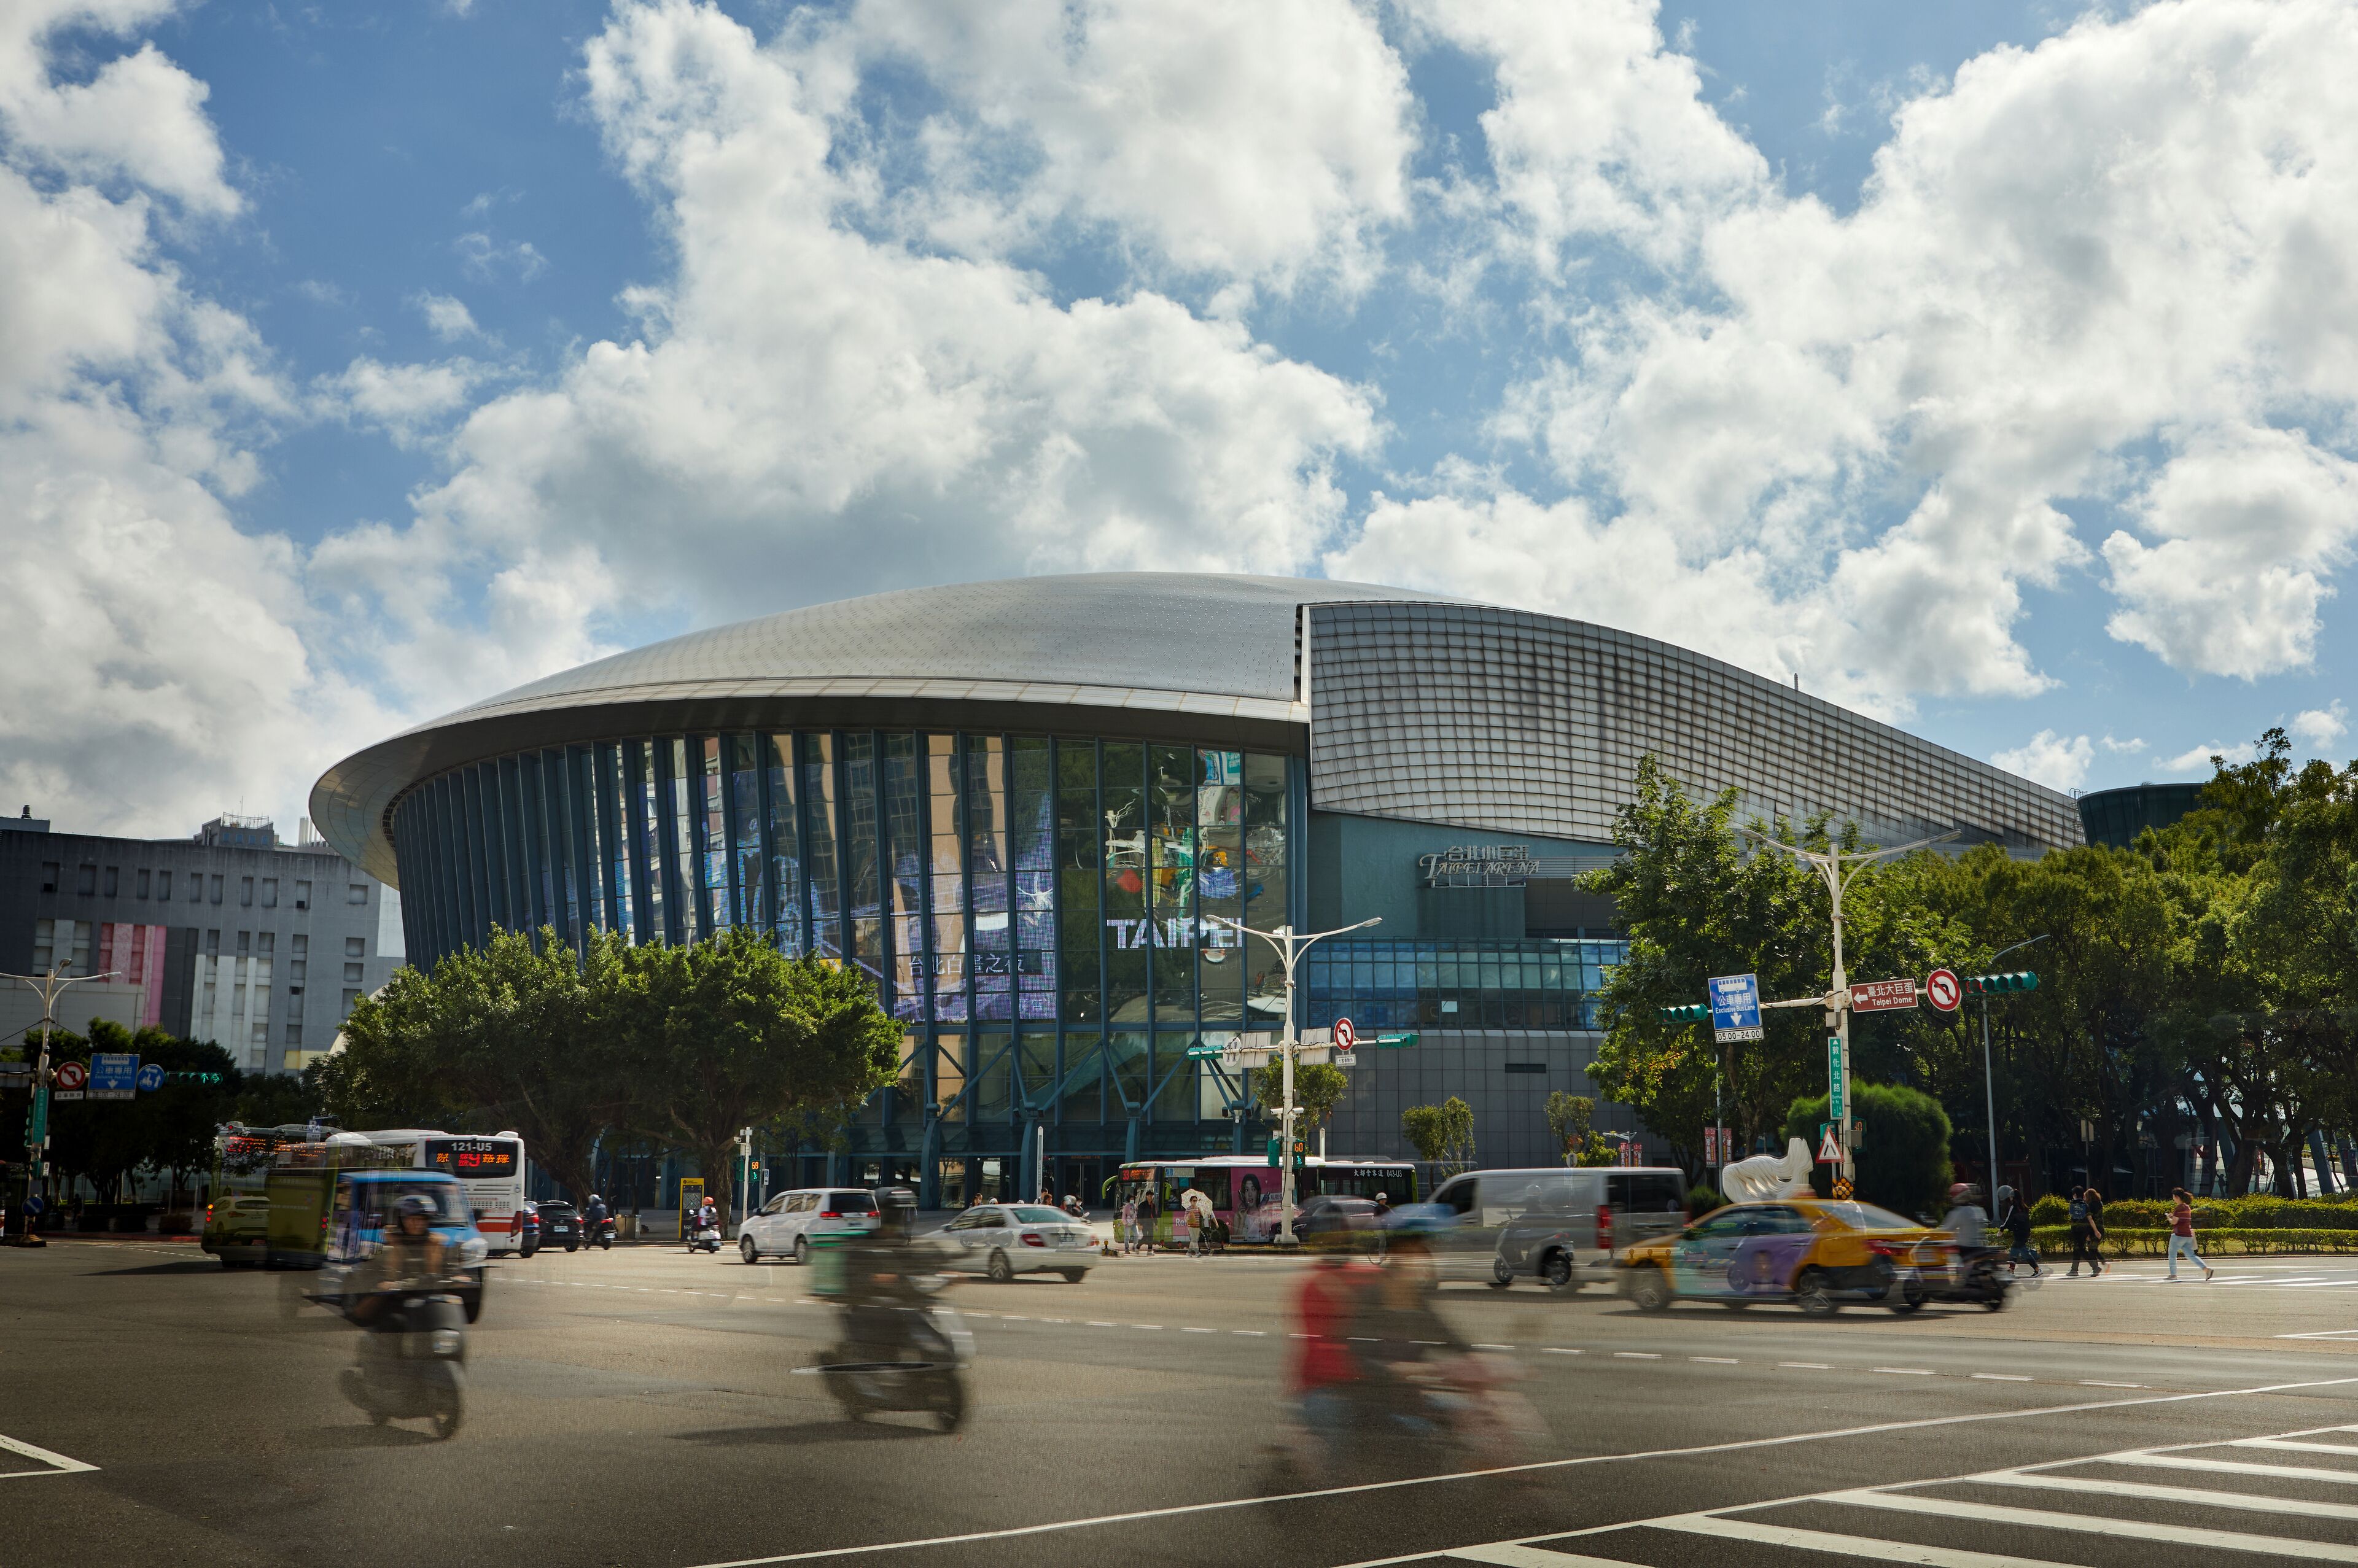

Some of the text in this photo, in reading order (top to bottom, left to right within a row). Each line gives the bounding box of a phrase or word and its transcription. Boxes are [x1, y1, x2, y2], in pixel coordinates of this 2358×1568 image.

[1448, 845, 1530, 861] 台北小巨蛋
[1419, 850, 1539, 879] TAIPEI ARENA
[1107, 917, 1242, 949] TAIPEI
[1867, 982, 1914, 998] 臺北大巨蛋
[1718, 992, 1751, 1006] 公車專用
[1872, 997, 1892, 1007] Taipei
[1832, 1046, 1840, 1092] 敦化北路
[451, 1142, 492, 1152] 121-U5
